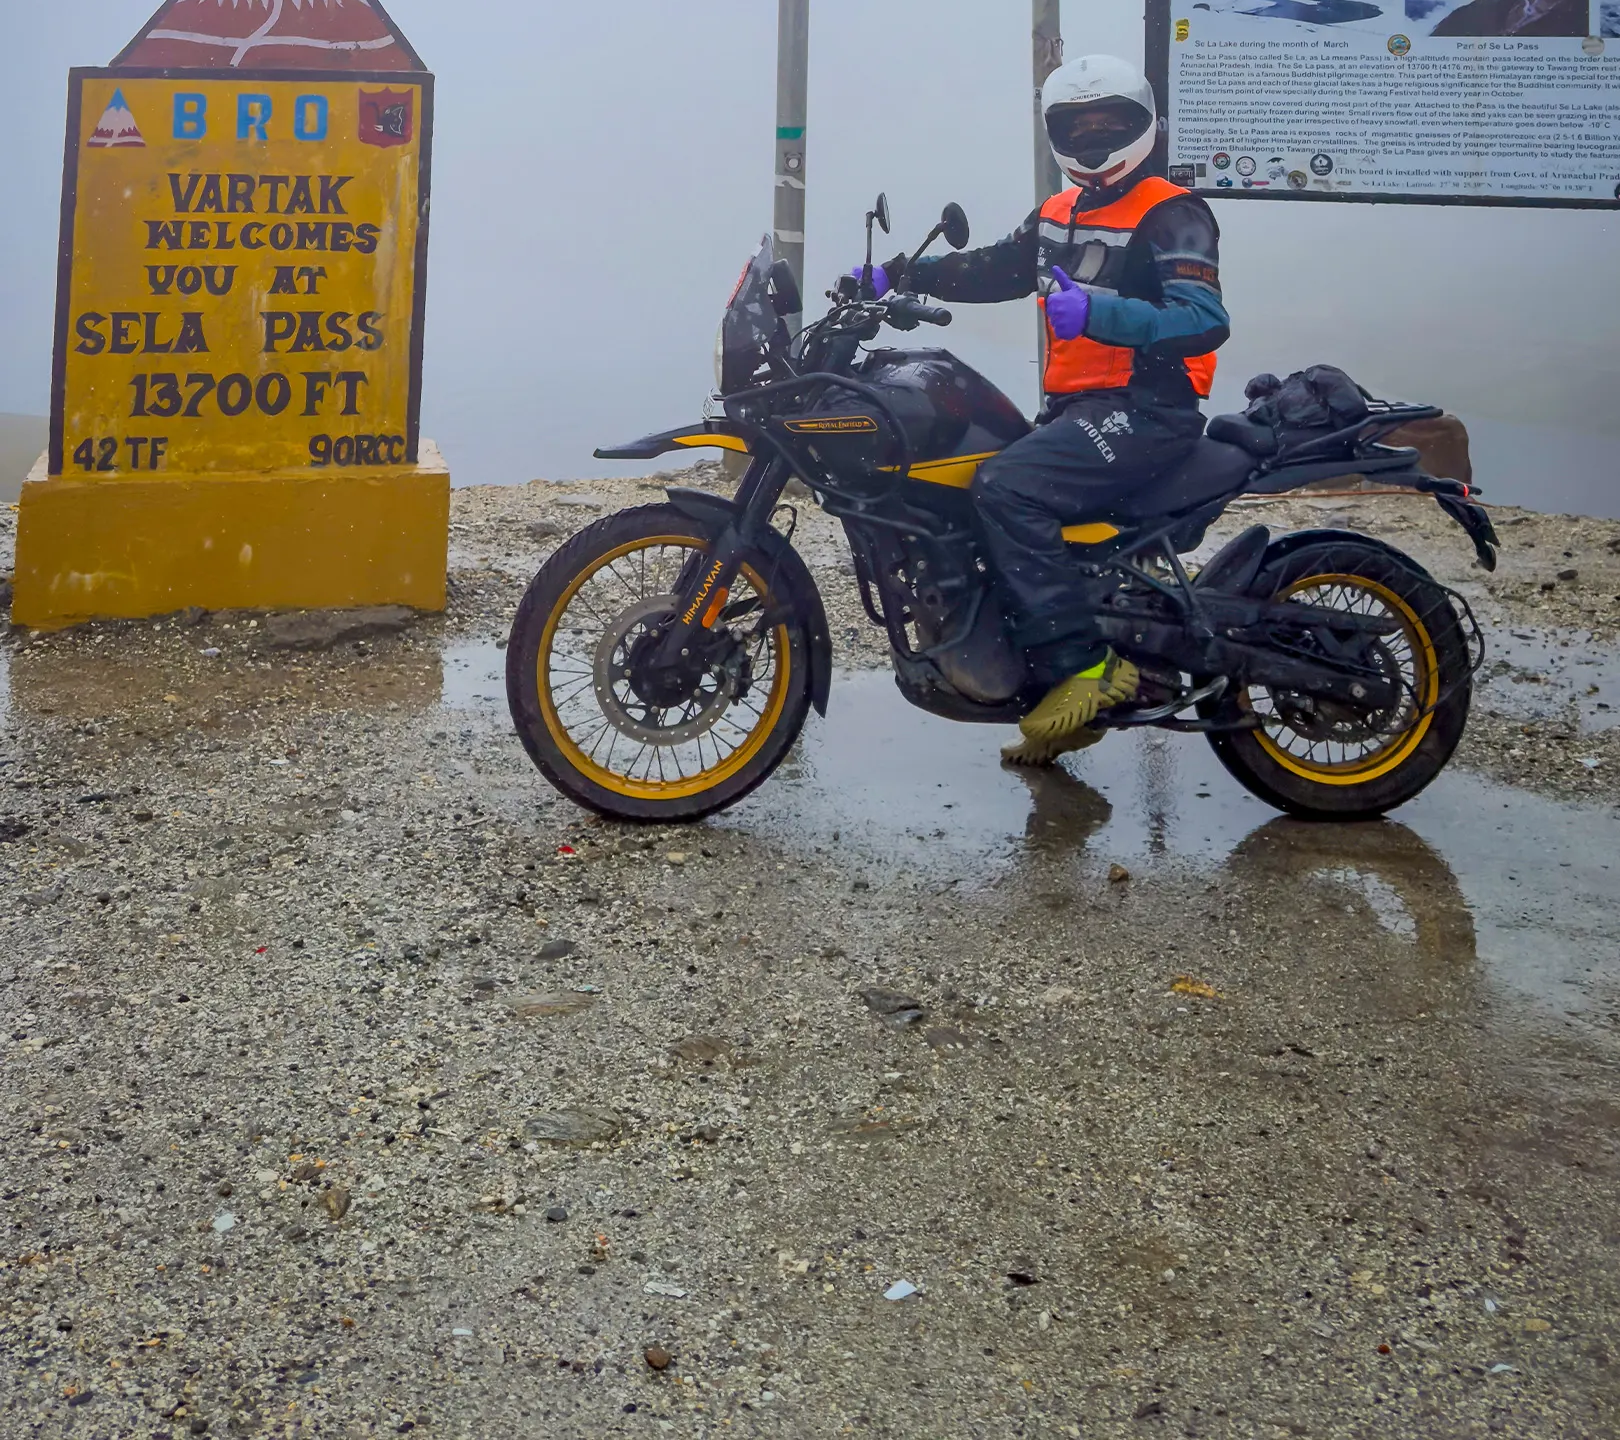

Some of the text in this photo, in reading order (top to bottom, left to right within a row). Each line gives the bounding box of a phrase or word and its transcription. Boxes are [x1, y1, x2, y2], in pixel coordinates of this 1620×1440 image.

[1195, 40, 1205, 48] Se
[1239, 41, 1266, 49] during
[1457, 42, 1474, 50] Part
[1478, 42, 1487, 50] of
[1489, 42, 1501, 50] Se
[1360, 54, 1382, 62] Pass)
[1605, 104, 1620, 112] (als
[1178, 136, 1202, 144] Group
[1245, 137, 1269, 145] higher
[1271, 137, 1312, 146] Himalayan
[1544, 143, 1575, 151] bearing
[1178, 152, 1210, 161] Orogeny
[1286, 146, 1316, 154] Tawang
[1317, 148, 1348, 156] passing
[1350, 148, 1380, 156] through
[1462, 150, 1489, 158] unique
[1491, 151, 1539, 159] opportunity
[1551, 151, 1573, 160] study
[1454, 171, 1487, 179] support
[1552, 172, 1596, 180] Arunachal
[167, 173, 354, 215] VARTAK
[143, 220, 382, 254] WELCOMES
[143, 265, 328, 295] YOU AT
[74, 311, 387, 354] SELA PASS
[128, 371, 369, 417] 13700 FT
[73, 436, 121, 471] 42
[125, 436, 169, 470] TF
[682, 560, 723, 625] HIMALAYAN
